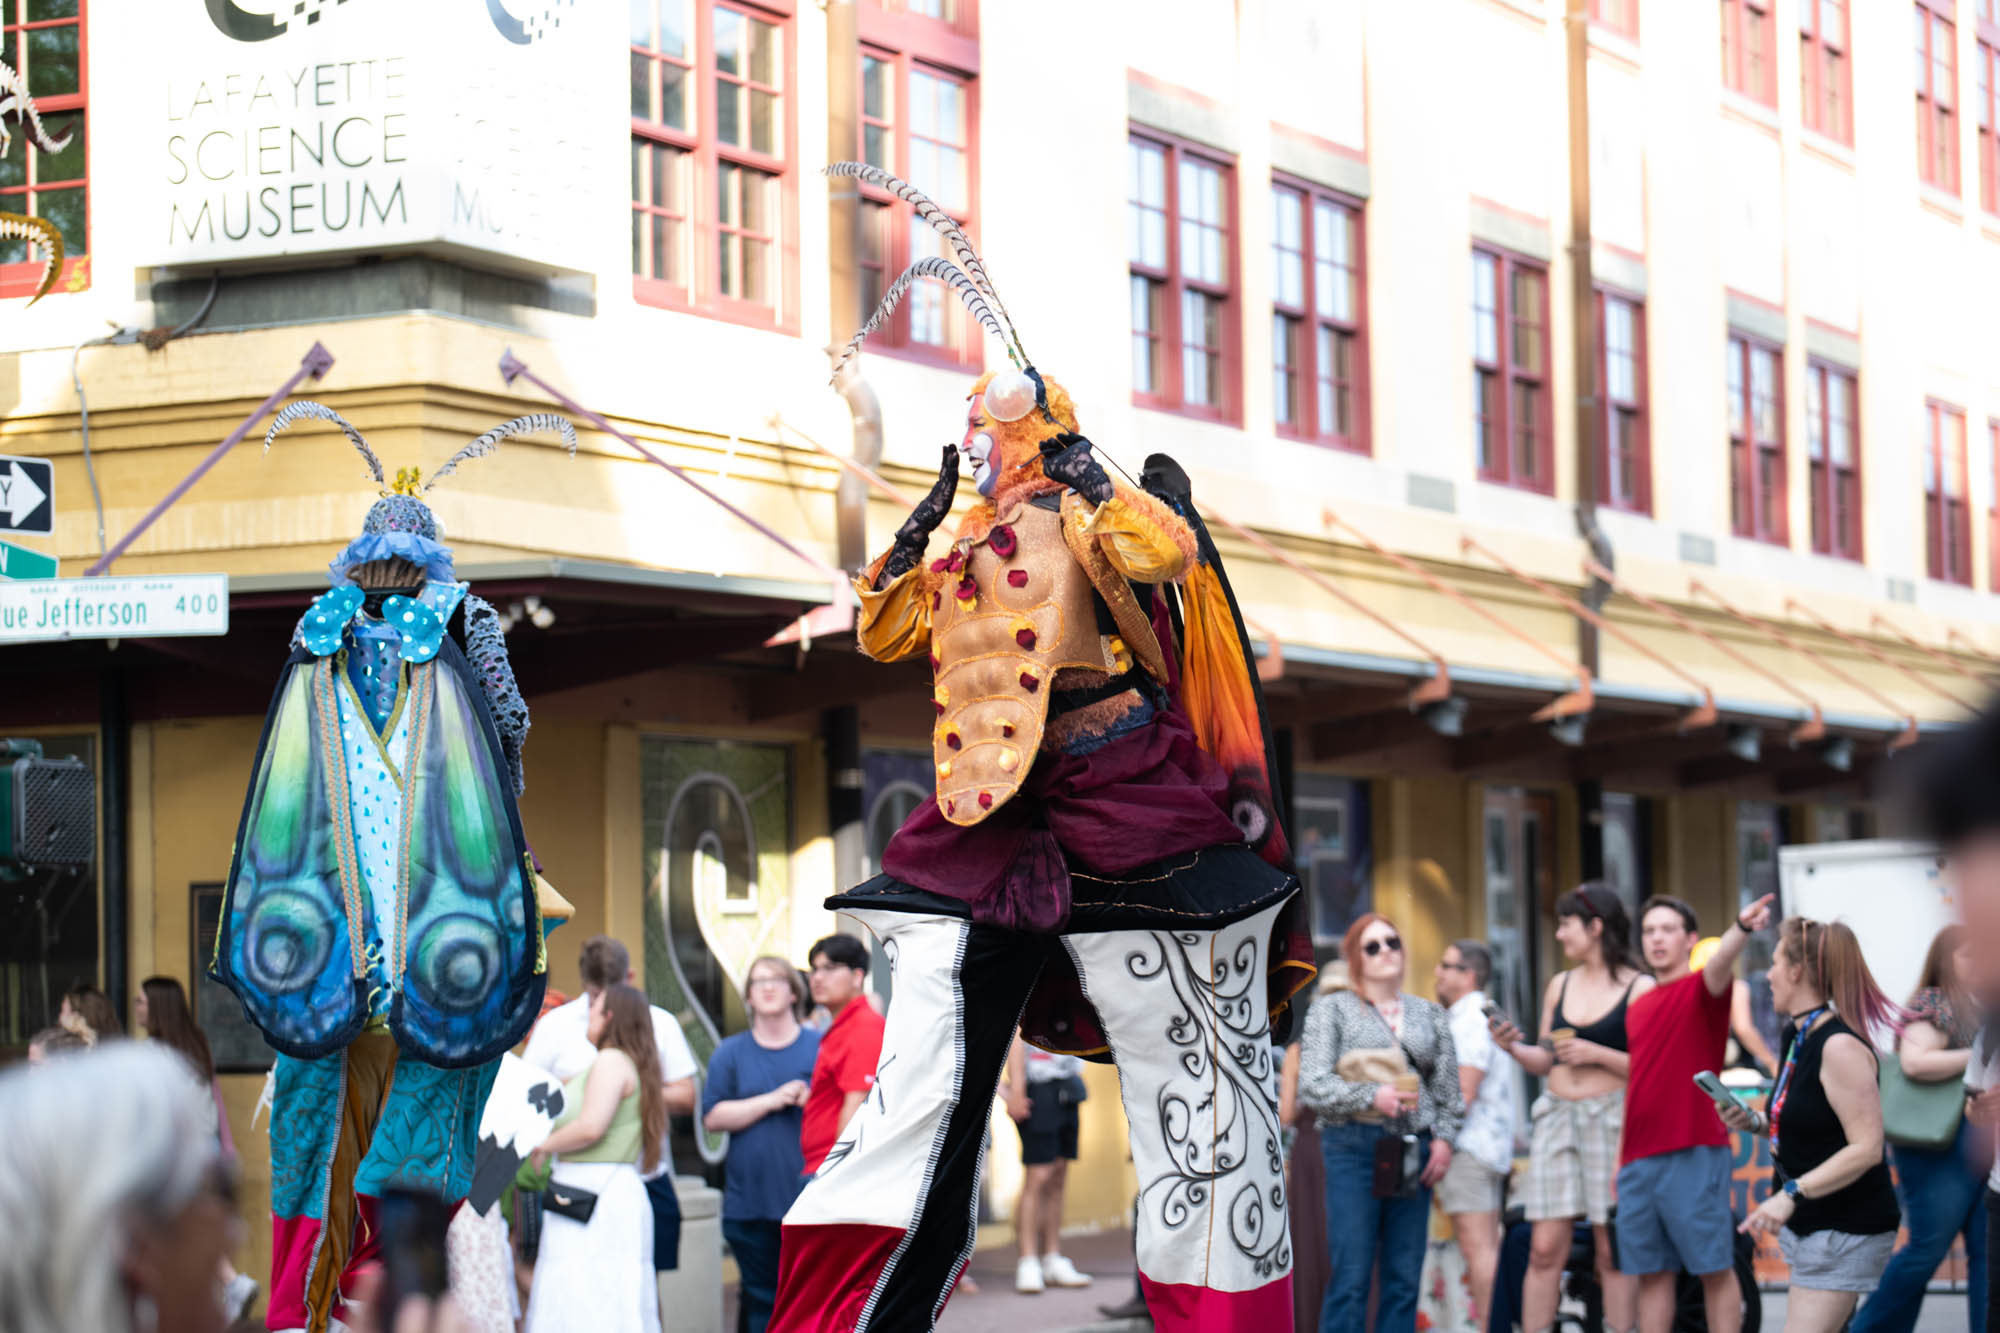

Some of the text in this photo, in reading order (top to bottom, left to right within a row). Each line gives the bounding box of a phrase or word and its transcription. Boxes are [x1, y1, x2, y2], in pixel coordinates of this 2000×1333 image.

[167, 57, 406, 121] LAFAYETTE
[167, 113, 407, 185] SCIENCE
[169, 177, 408, 246] MUSEUM
[0, 593, 219, 629] ue Jefferson 400
